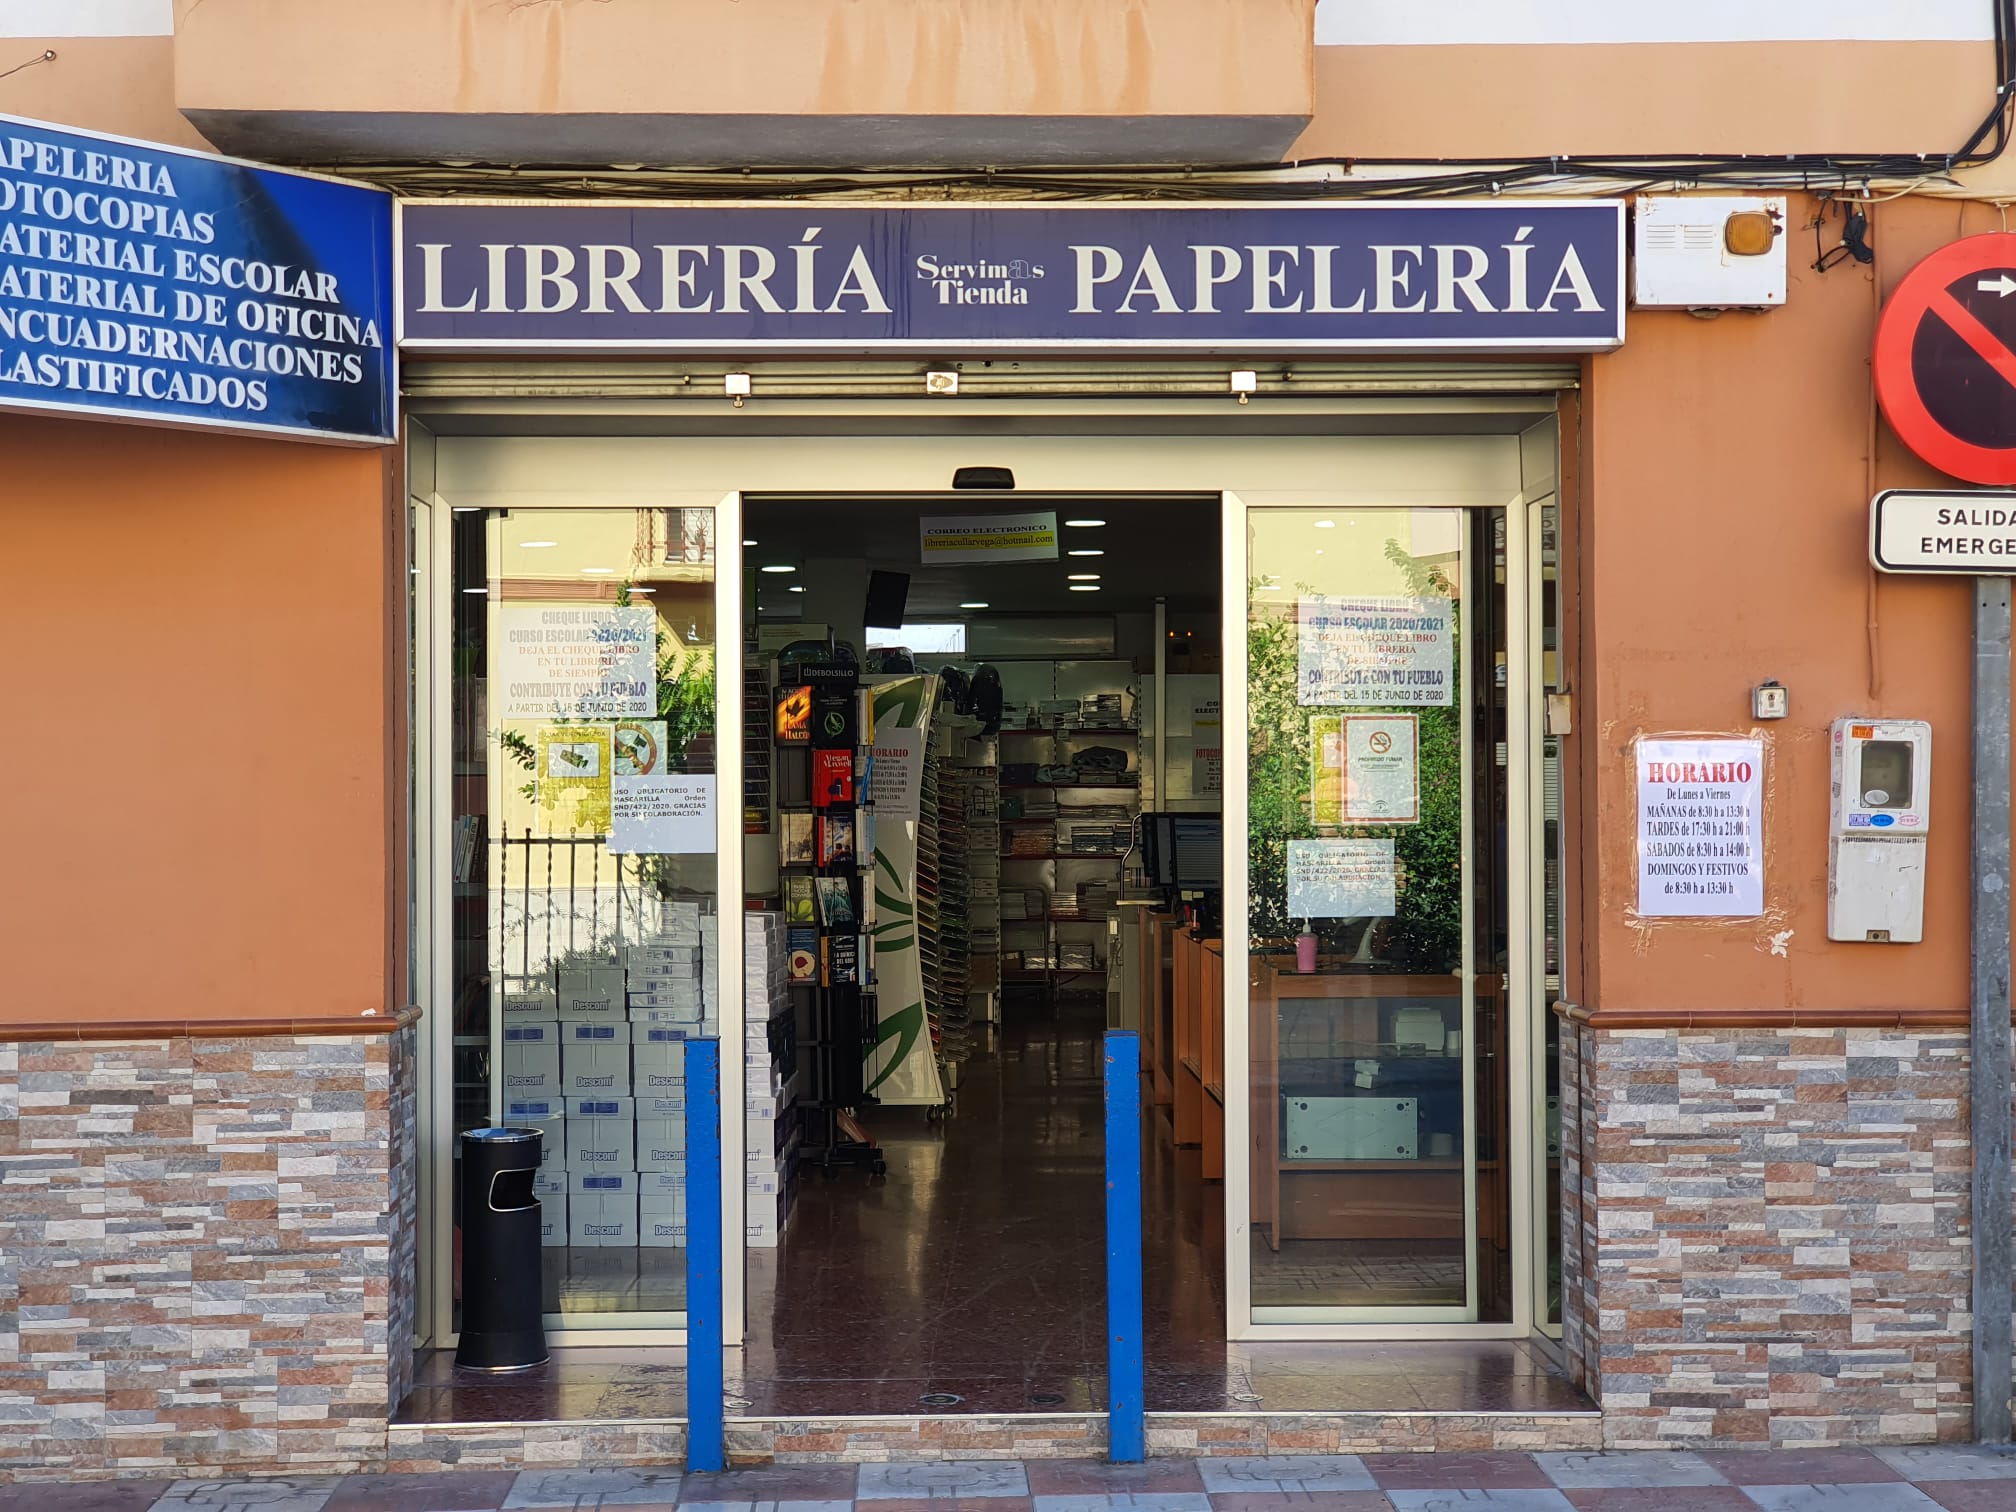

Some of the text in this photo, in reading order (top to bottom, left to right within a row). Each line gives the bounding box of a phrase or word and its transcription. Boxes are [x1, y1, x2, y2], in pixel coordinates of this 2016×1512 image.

[415, 227, 893, 313] LIBRERÍA
[916, 254, 1045, 280] Servimas
[1068, 226, 1605, 313] PAPELERÍA
[174, 248, 340, 304] ESCOLAR
[931, 279, 1029, 304] Tienda
[174, 289, 228, 327] DE
[237, 299, 382, 349] OFICINA
[973, 525, 1047, 534] ELECTRONICO
[1920, 537, 2016, 555] EMERGE
[542, 611, 580, 625] CHEQUE
[1390, 617, 1444, 631] 2020/2021
[510, 629, 543, 643] CURSO
[1318, 633, 1343, 642] DEJA
[1406, 633, 1438, 642] LIBRO
[519, 645, 640, 656] DEJA EL CHEQUE LIBRO
[537, 657, 553, 666] EN
[554, 657, 568, 666] TU
[549, 669, 562, 678] DE
[1392, 670, 1406, 685] TU
[1407, 670, 1444, 685] PUEBLO
[510, 682, 571, 698] CONTRIBUYE
[1372, 690, 1382, 700] DE
[1385, 690, 1411, 700] JUNIO
[1413, 690, 1423, 700] DE
[1425, 690, 1444, 700] 2020
[508, 703, 514, 713] A
[515, 703, 544, 713] PARTIR
[575, 702, 585, 712] DE
[588, 702, 614, 712] JUNIO
[616, 702, 626, 711] DE
[629, 702, 647, 711] 2020
[1647, 762, 1752, 783] HORARIO
[1667, 788, 1731, 800] De Lunes a Viernes
[1647, 803, 1687, 817] MAÑANAS
[1688, 805, 1697, 817] de
[1699, 805, 1713, 817] 8:30
[1714, 805, 1719, 817] h
[1720, 809, 1725, 817] a
[1726, 805, 1744, 817] 13:30
[1647, 821, 1680, 836] TARDES
[1681, 821, 1690, 836] de
[1692, 821, 1711, 836] 17:30
[1713, 821, 1717, 836] h
[1719, 826, 1723, 836] a
[1725, 821, 1744, 836] 21:00
[1647, 842, 1685, 857] SABADOS
[1686, 842, 1695, 857] de
[1696, 842, 1712, 857] 8:30
[1713, 842, 1718, 857] h
[1719, 847, 1724, 857] a
[1726, 842, 1745, 857] 14:00
[1647, 863, 1749, 875] DOMINGOS Y FESTIVOS
[1664, 882, 1734, 894] de 8:30 h a 13:30 h
